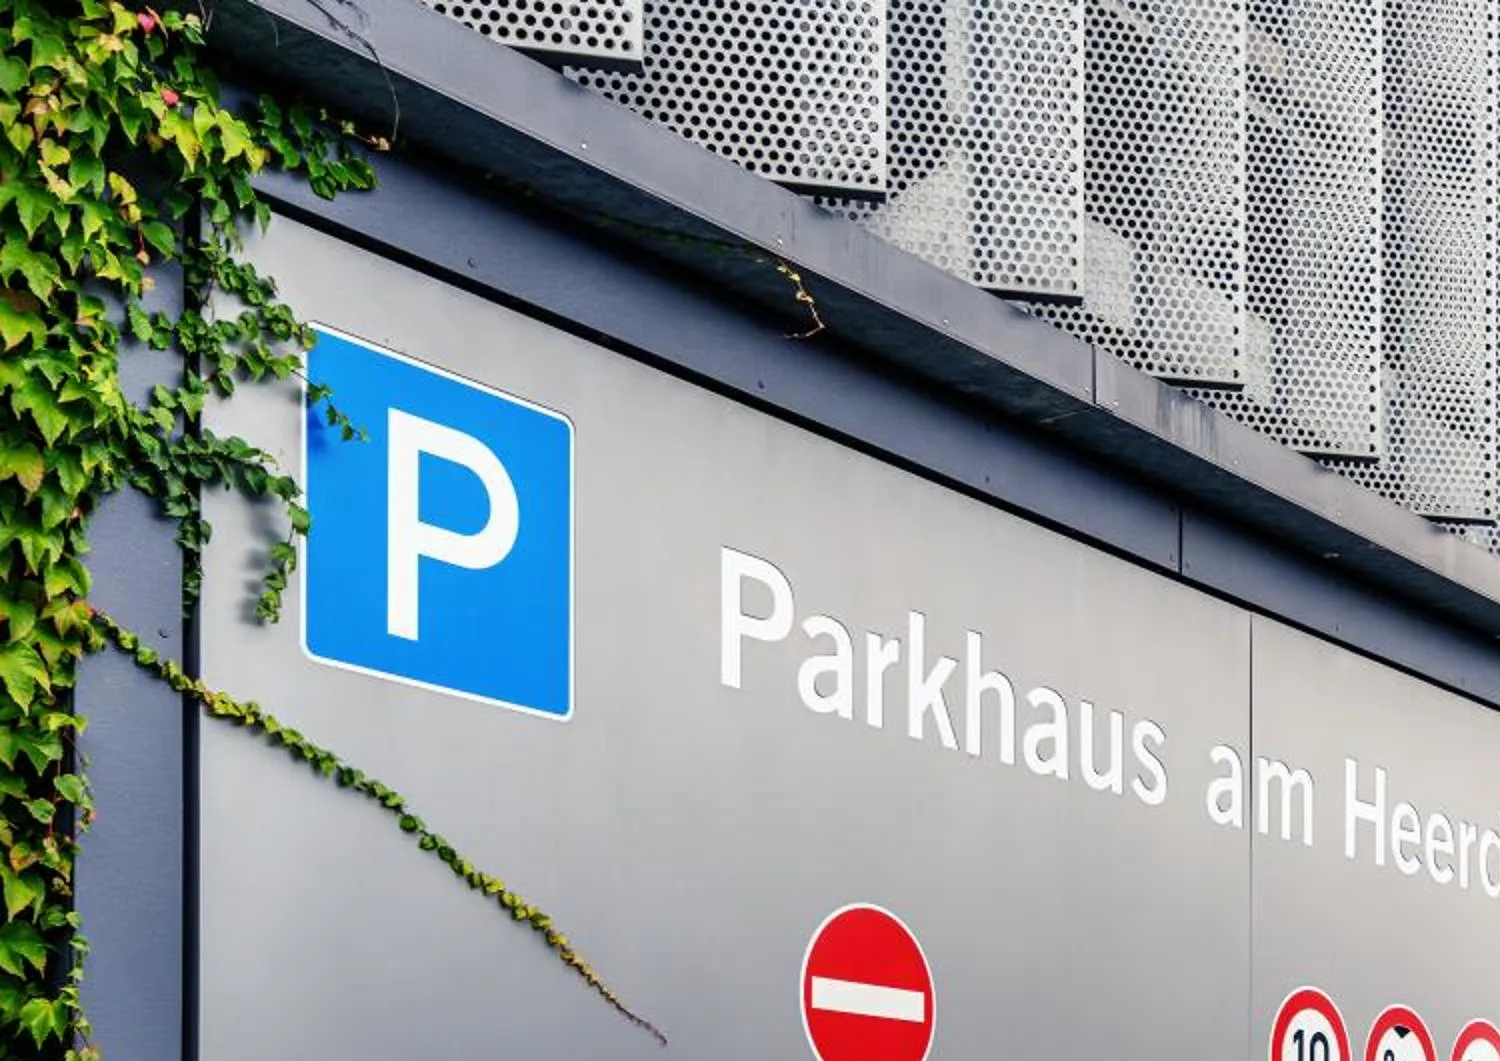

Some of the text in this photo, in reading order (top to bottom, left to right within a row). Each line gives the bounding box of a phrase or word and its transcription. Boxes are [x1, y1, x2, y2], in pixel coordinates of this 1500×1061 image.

[387, 407, 520, 641] P
[720, 546, 1168, 806] Parkhaus
[1206, 744, 1315, 847] am
